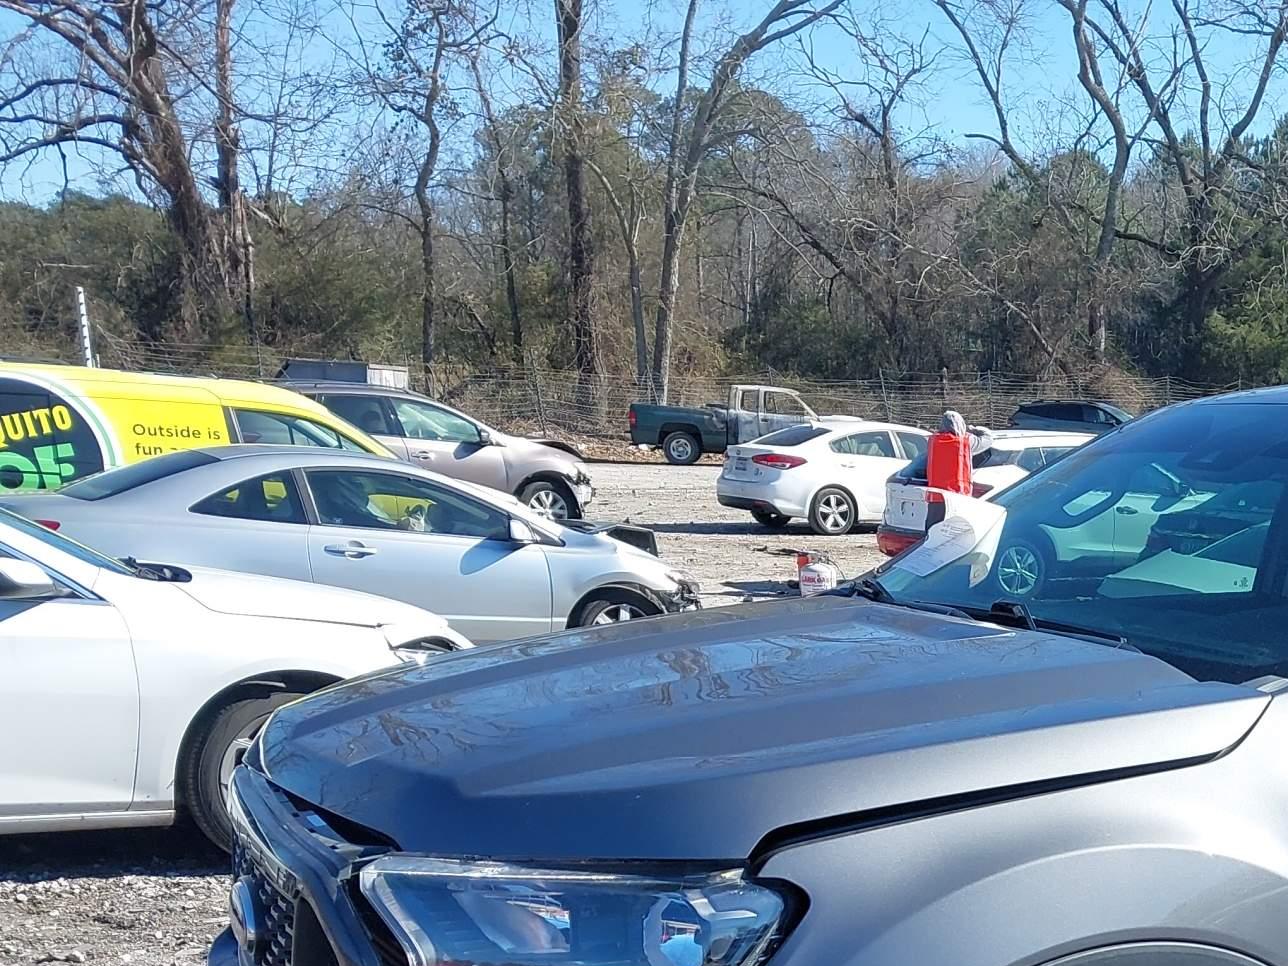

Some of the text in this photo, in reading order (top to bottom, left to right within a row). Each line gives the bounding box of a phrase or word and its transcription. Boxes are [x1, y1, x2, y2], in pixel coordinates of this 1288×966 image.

[132, 423, 221, 440] Outside is
[135, 442, 163, 456] fun
